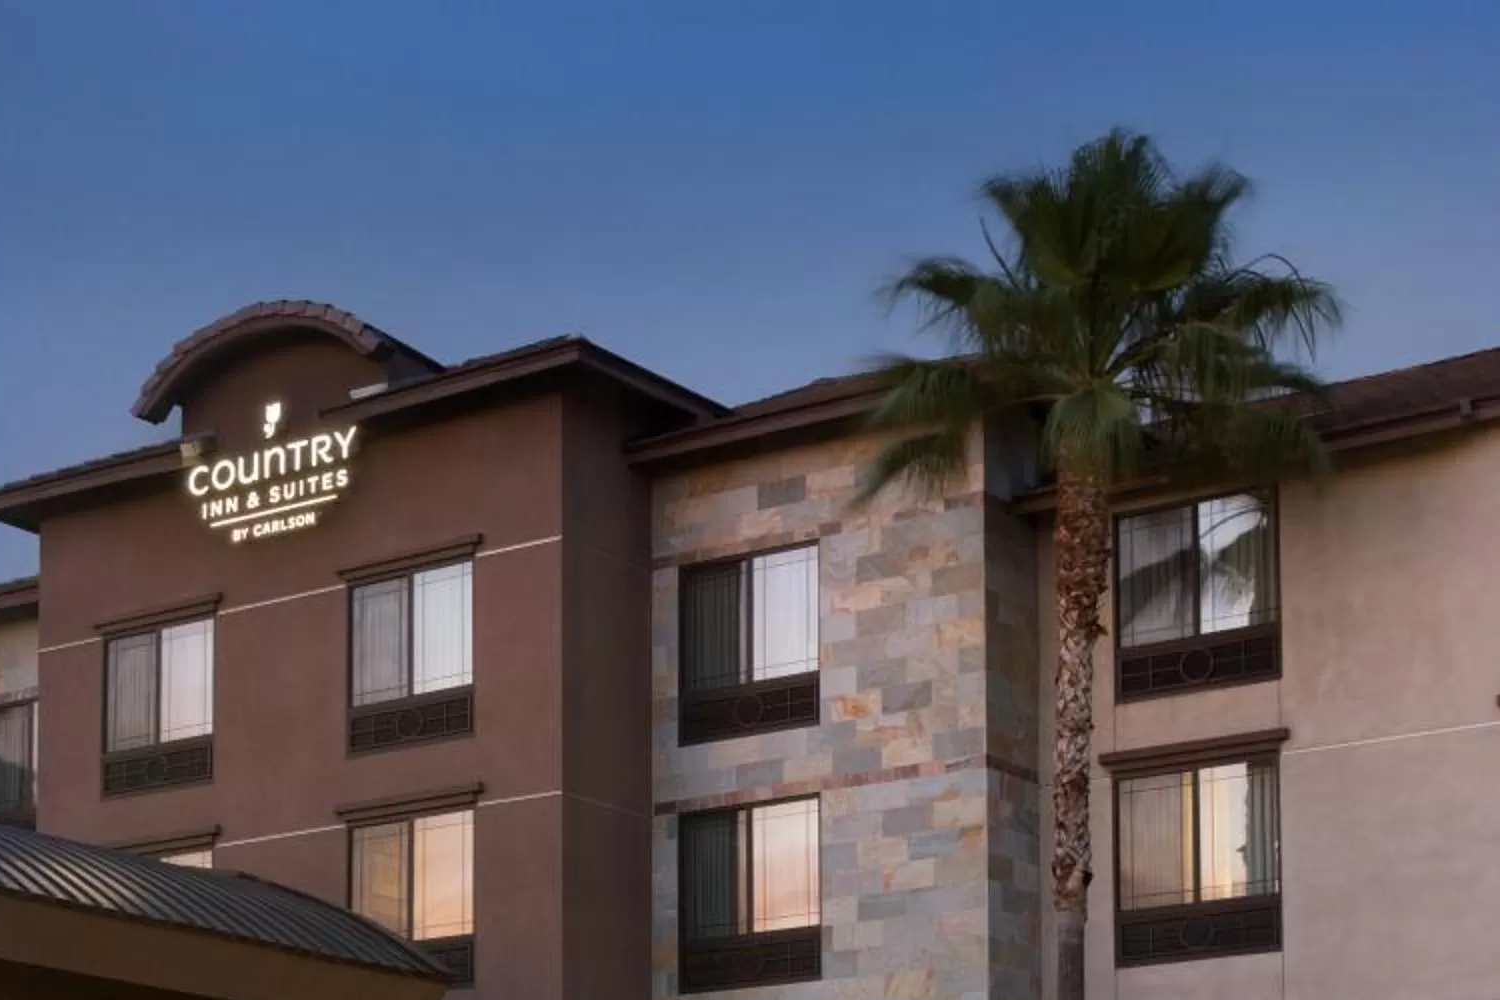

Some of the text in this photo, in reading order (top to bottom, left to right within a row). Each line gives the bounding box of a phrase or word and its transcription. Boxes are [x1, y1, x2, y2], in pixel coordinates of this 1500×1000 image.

[188, 425, 357, 496] COUNTRY
[201, 469, 349, 520] INN & SUITES
[232, 511, 316, 542] BY CARLSON
